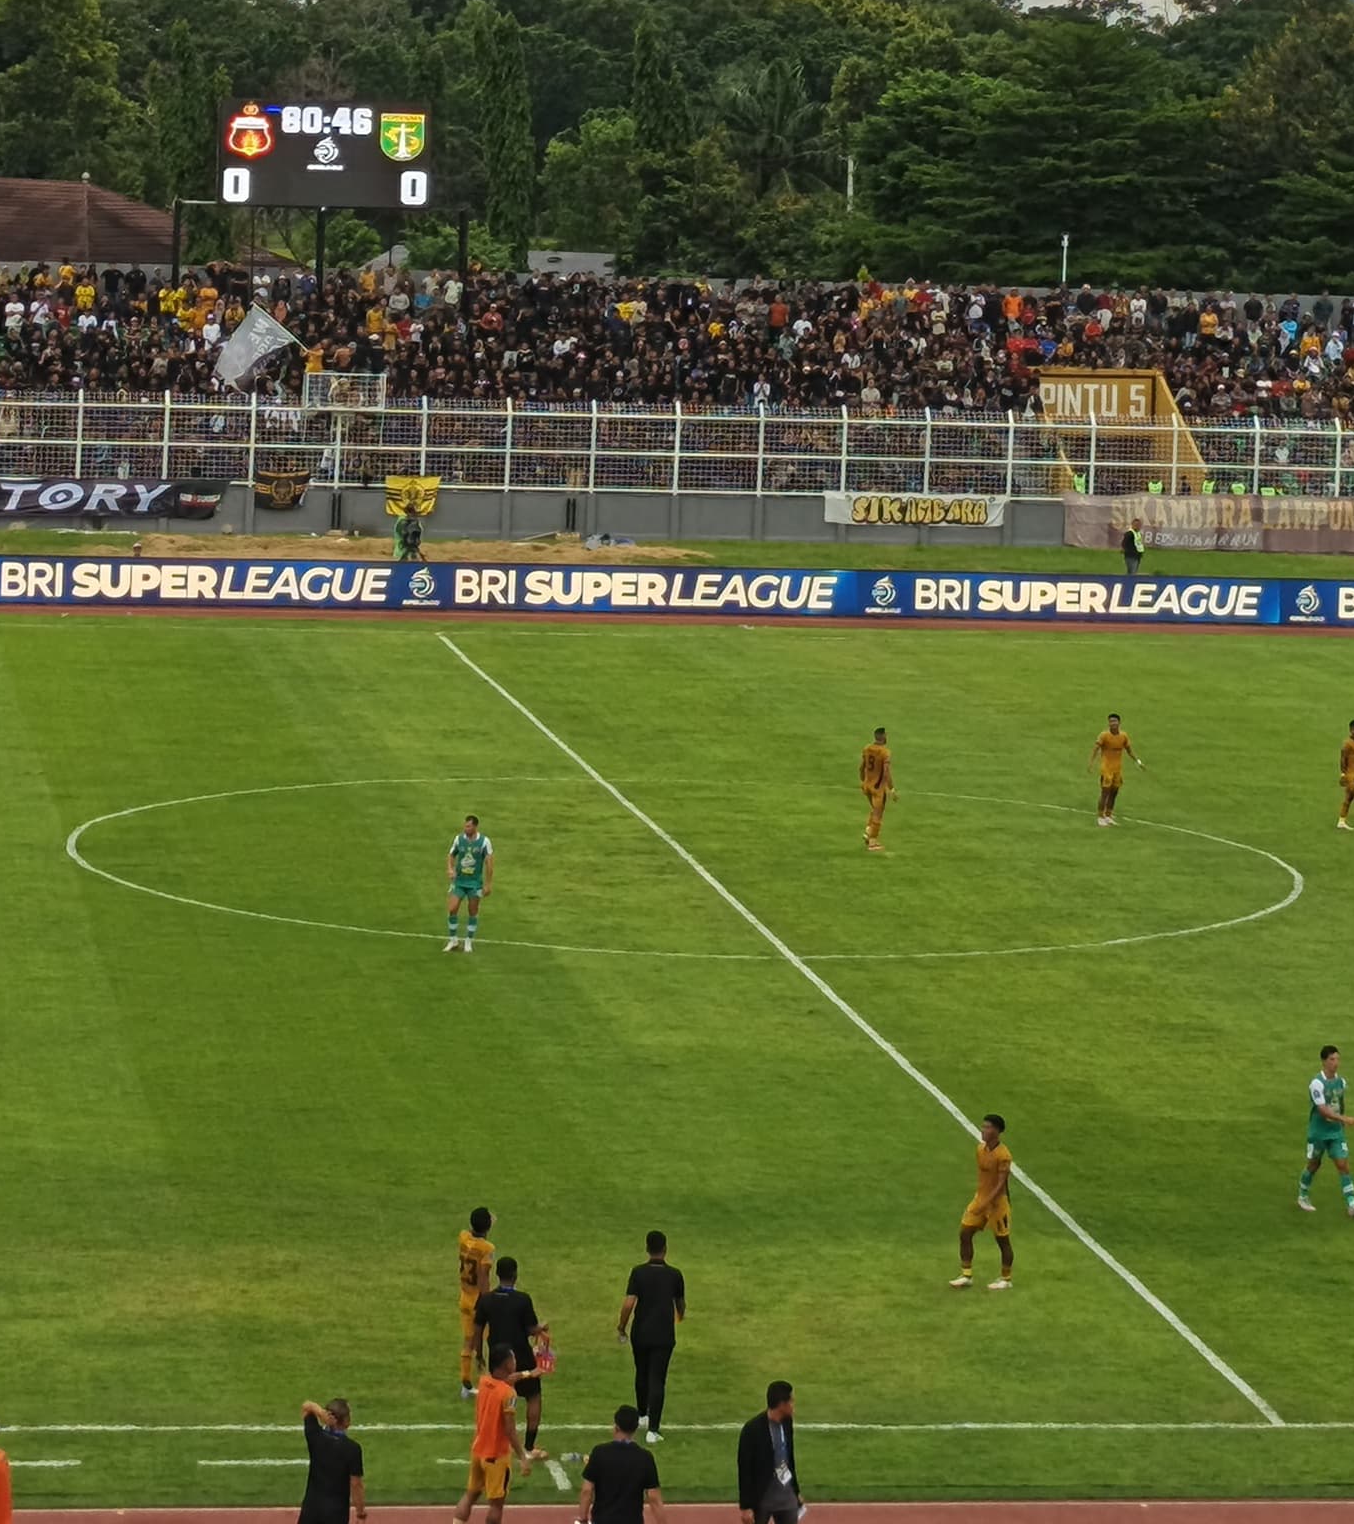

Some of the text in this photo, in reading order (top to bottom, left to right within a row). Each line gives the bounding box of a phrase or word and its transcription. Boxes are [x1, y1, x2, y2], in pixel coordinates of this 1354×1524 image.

[281, 105, 373, 135] 80:46
[222, 167, 251, 203] 0
[400, 170, 428, 205] 0
[1039, 383, 1147, 419] PINTU 5
[1109, 497, 1253, 532] SIKAMBARA
[0, 562, 64, 598] BRI
[455, 569, 517, 604] BRI
[914, 578, 970, 611] BRI
